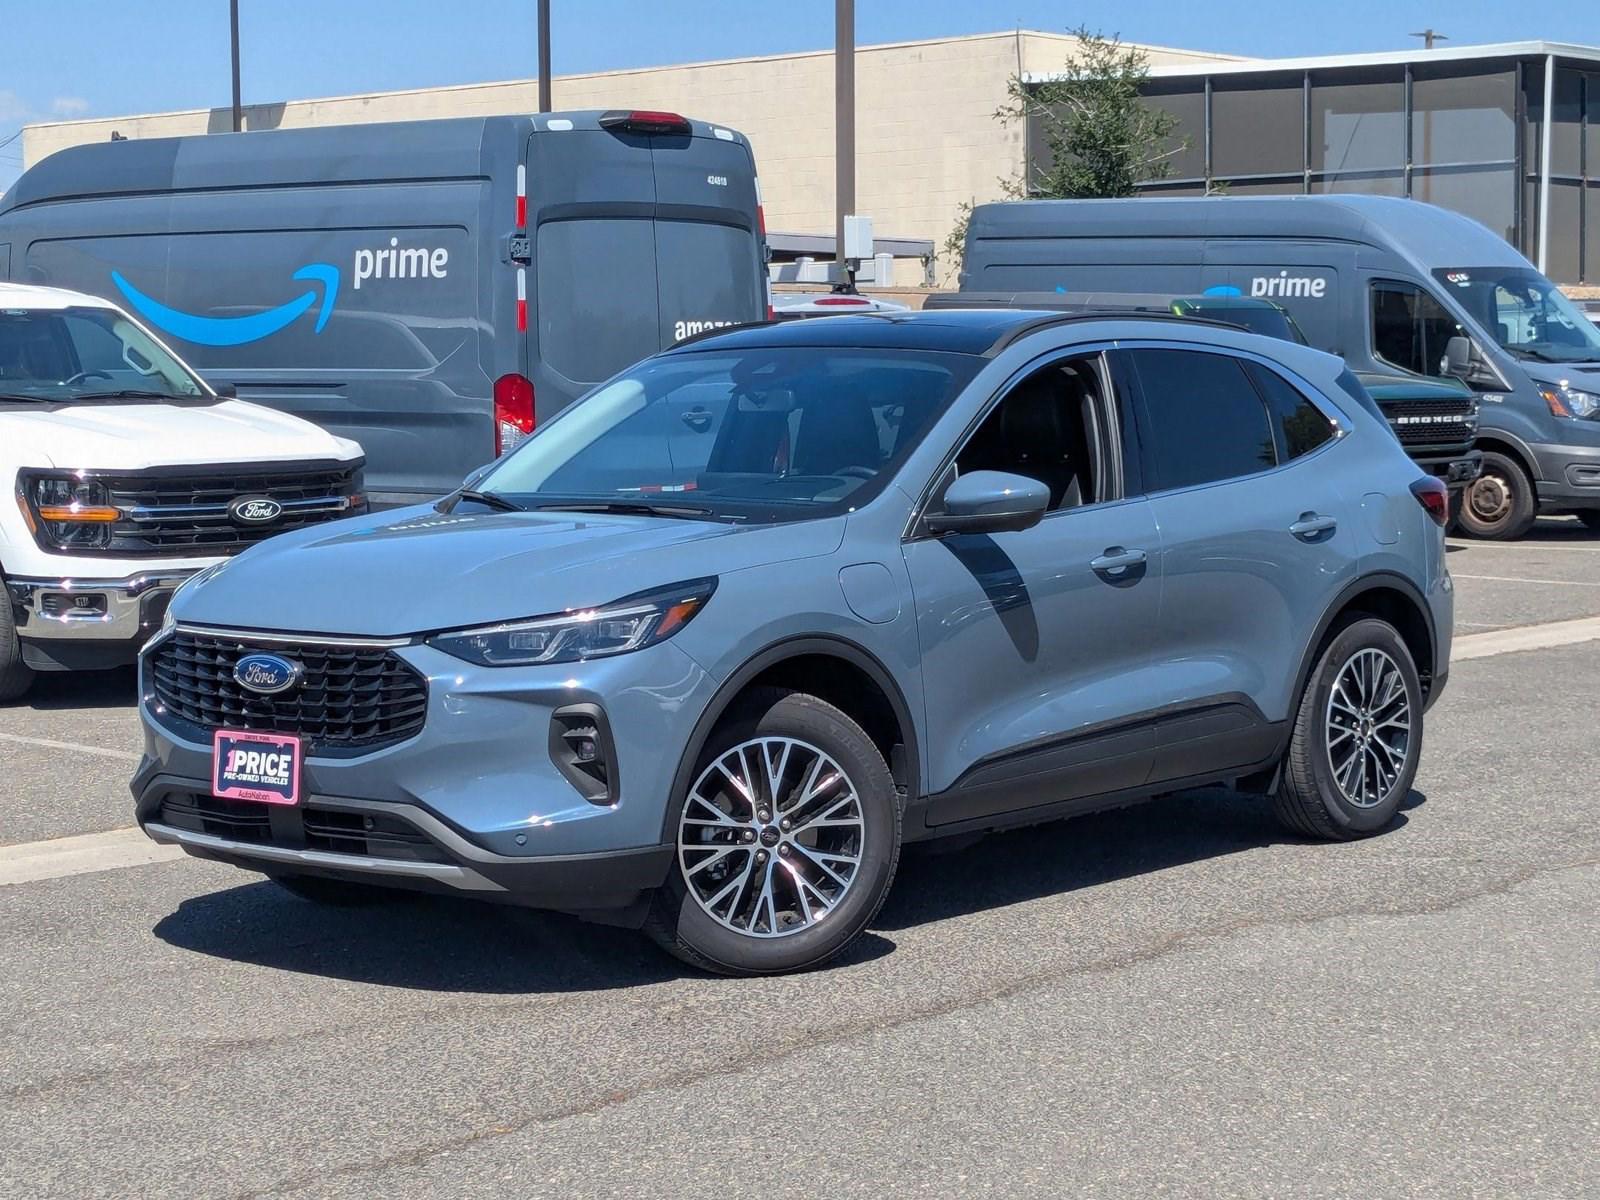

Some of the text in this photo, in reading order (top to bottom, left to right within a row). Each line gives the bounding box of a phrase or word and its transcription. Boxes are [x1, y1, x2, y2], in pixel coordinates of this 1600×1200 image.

[354, 237, 448, 289] prime
[1251, 270, 1326, 297] prime
[1397, 415, 1463, 424] BRONCO
[245, 502, 273, 517] Ford
[245, 662, 278, 684] Ford
[223, 772, 289, 785] PRE-OWNED VEHICLES
[238, 790, 270, 801] AutoNation
